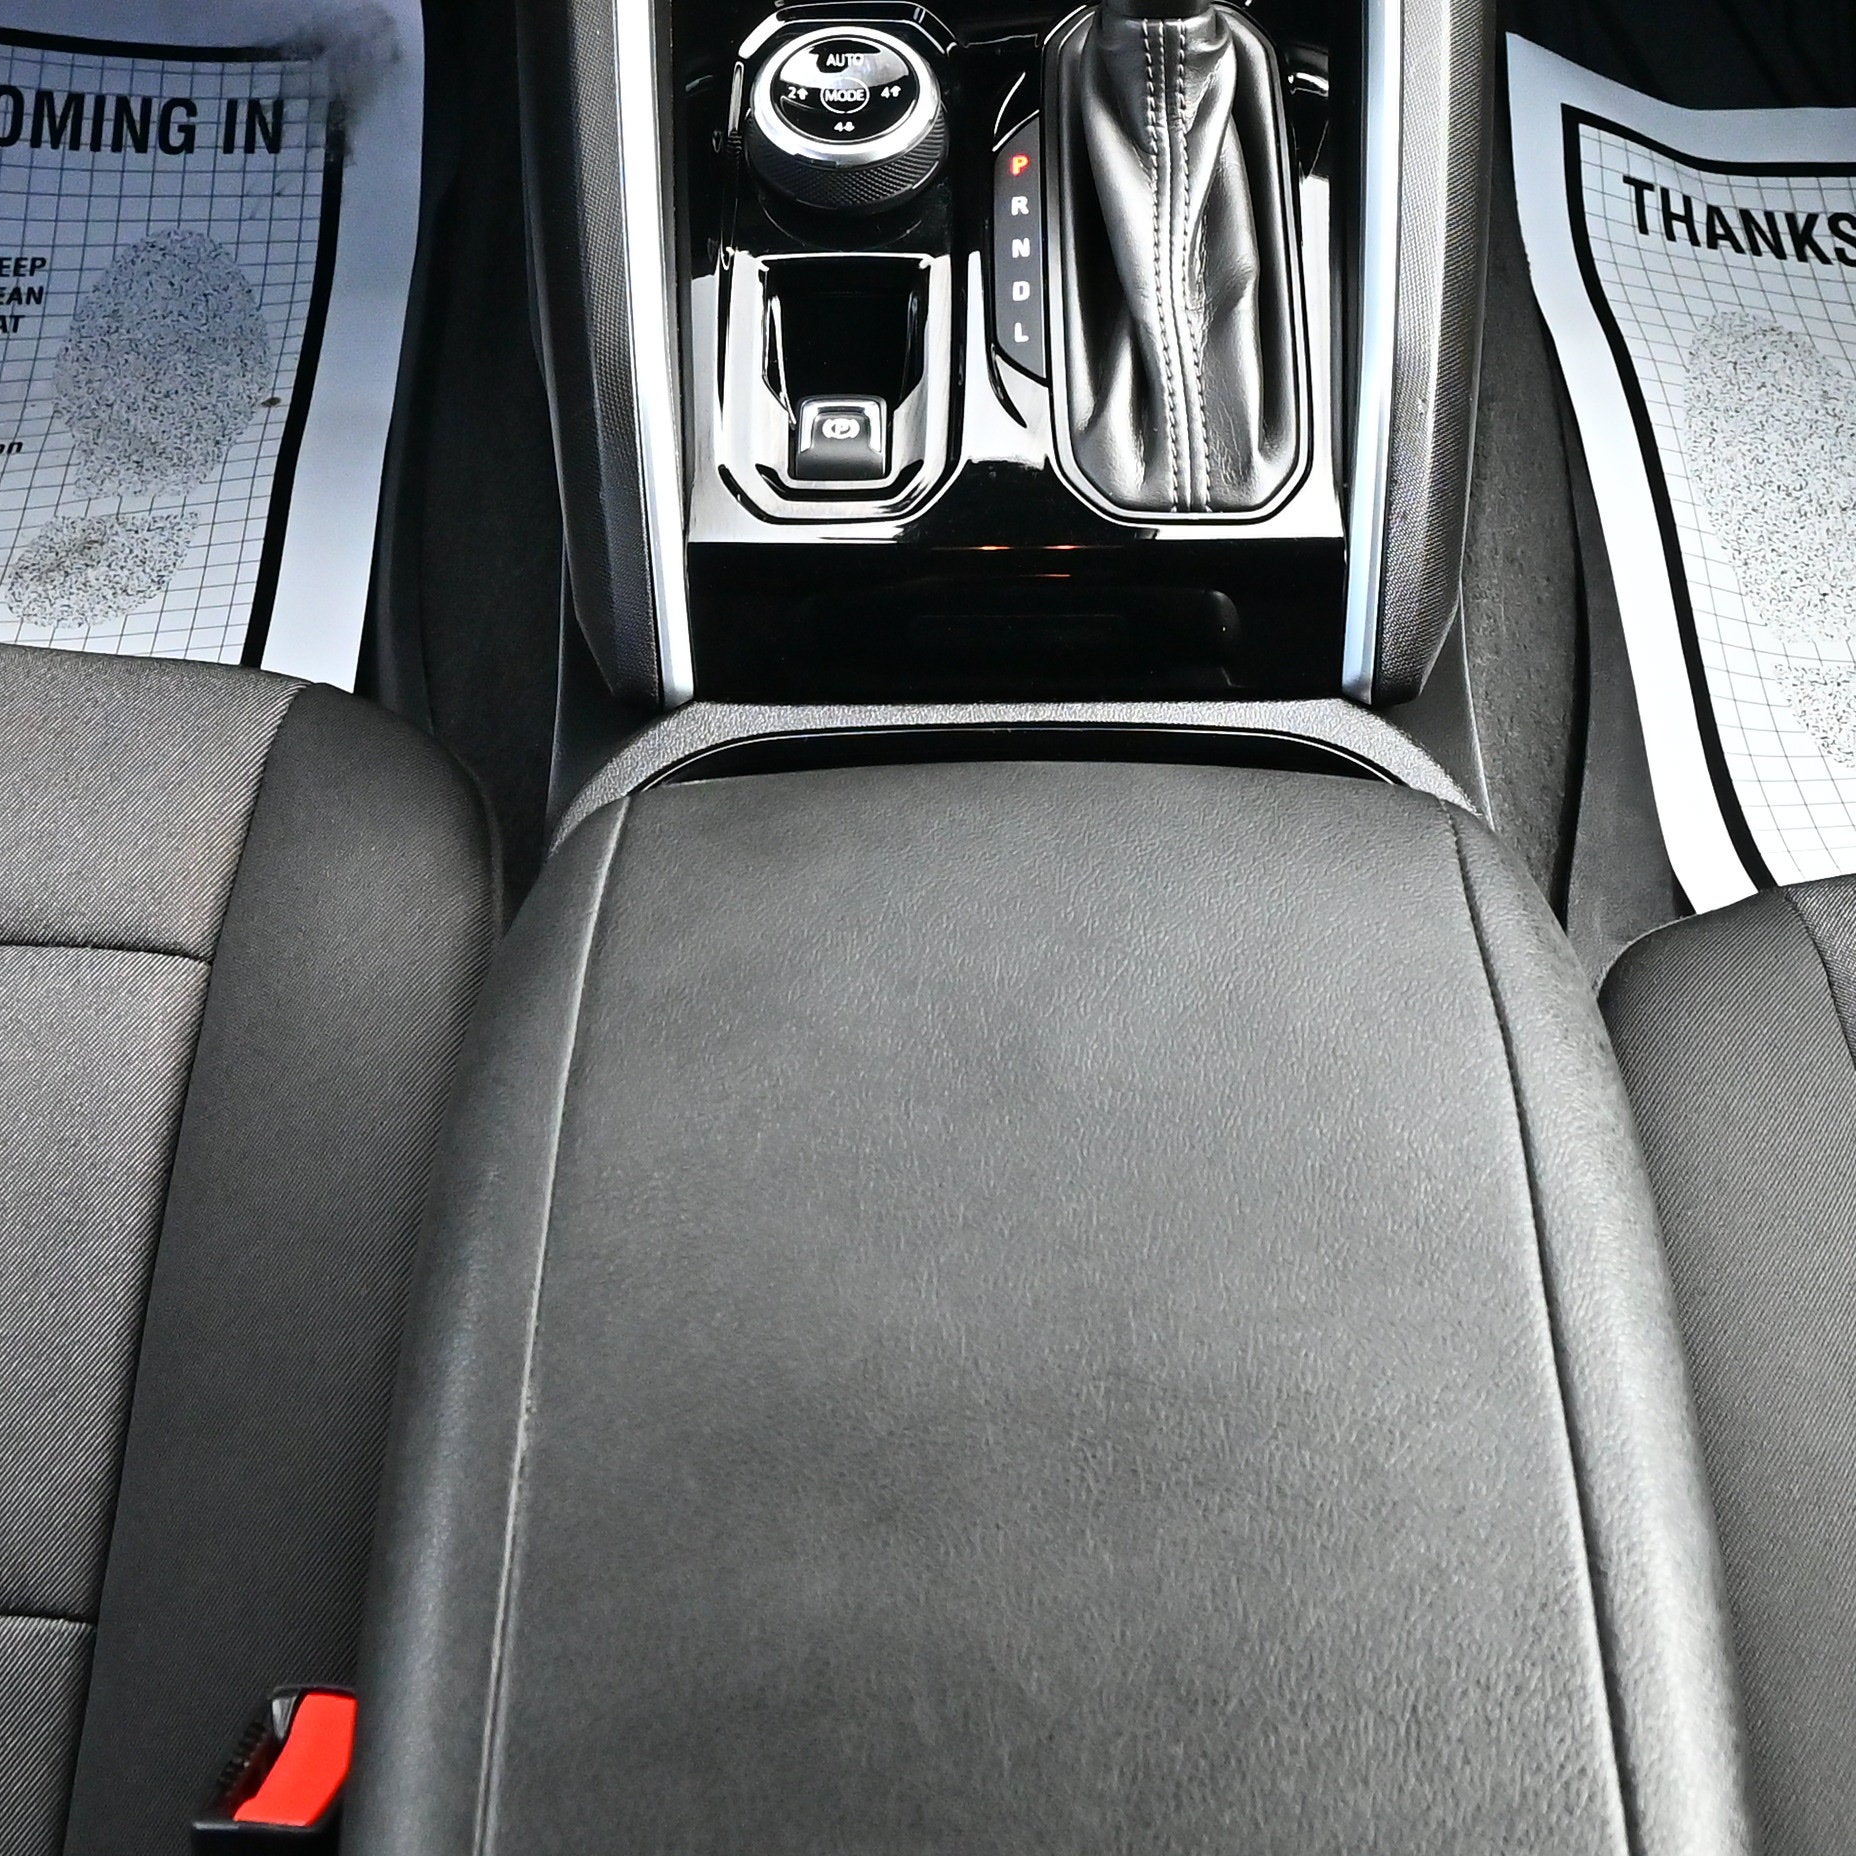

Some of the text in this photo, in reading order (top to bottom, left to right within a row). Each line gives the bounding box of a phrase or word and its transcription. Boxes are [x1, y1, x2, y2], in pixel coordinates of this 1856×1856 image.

[826, 53, 864, 67] AUTO
[825, 89, 865, 102] MODE
[222, 97, 285, 155] IN
[1011, 154, 1028, 175] P
[1011, 195, 1029, 216] R
[1011, 238, 1031, 258] N
[1012, 281, 1029, 302] D
[1014, 323, 1029, 343] L
